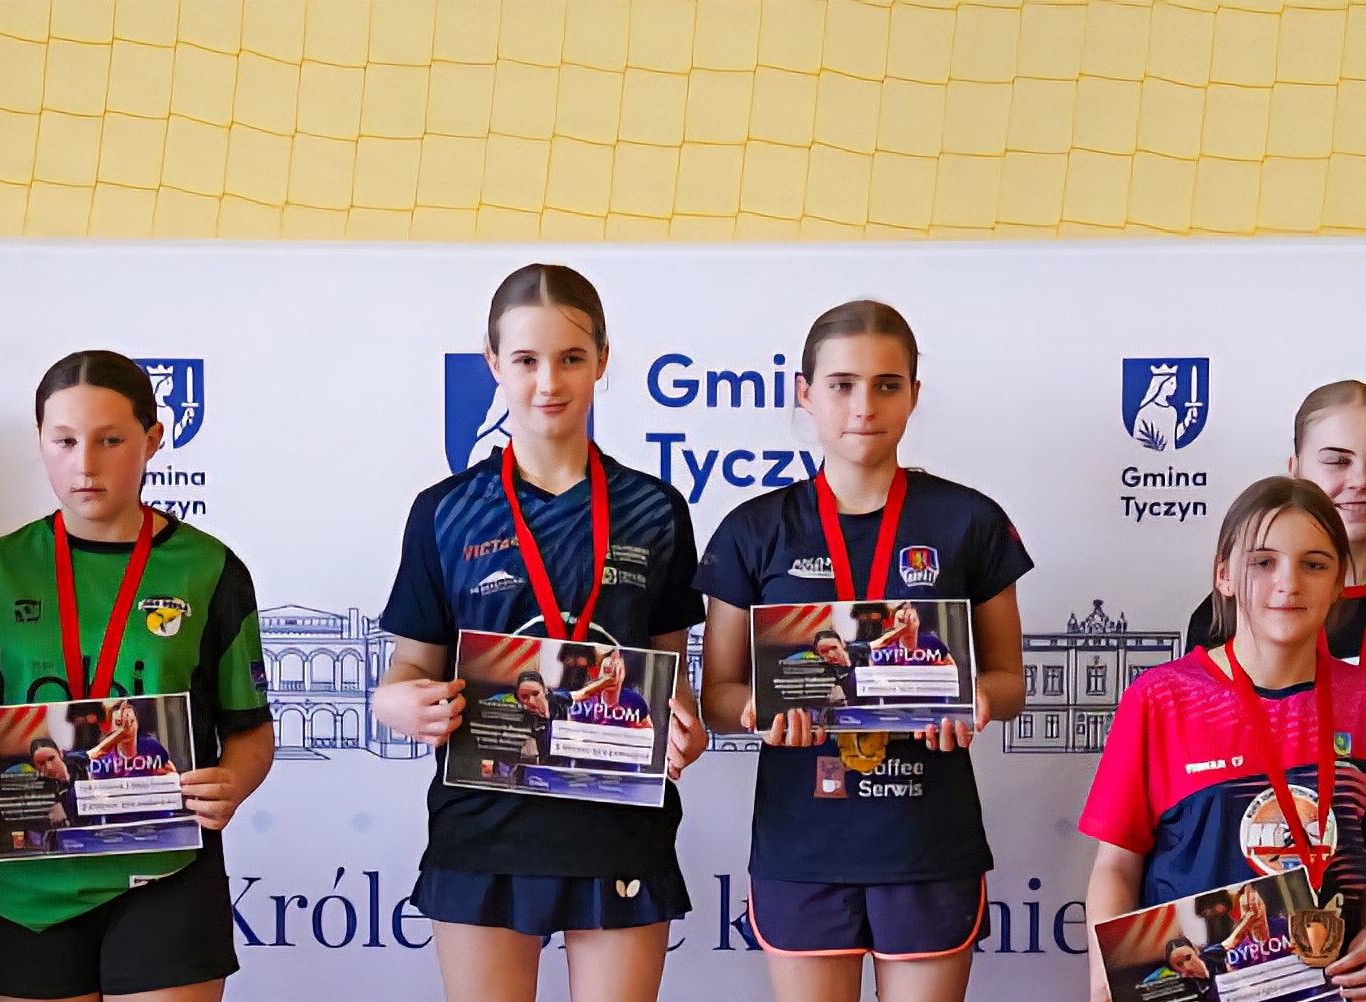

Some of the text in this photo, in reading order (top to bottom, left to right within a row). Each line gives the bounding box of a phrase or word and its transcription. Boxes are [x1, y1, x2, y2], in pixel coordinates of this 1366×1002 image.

[647, 353, 803, 408] Gmi
[143, 465, 206, 486] mina
[645, 432, 825, 504] Tyczy
[1121, 466, 1207, 487] Gmina
[1120, 496, 1207, 522] Tyczyn
[570, 699, 640, 723] DYPLOM
[90, 754, 163, 774] DYPLOM
[858, 779, 923, 797] Serwis
